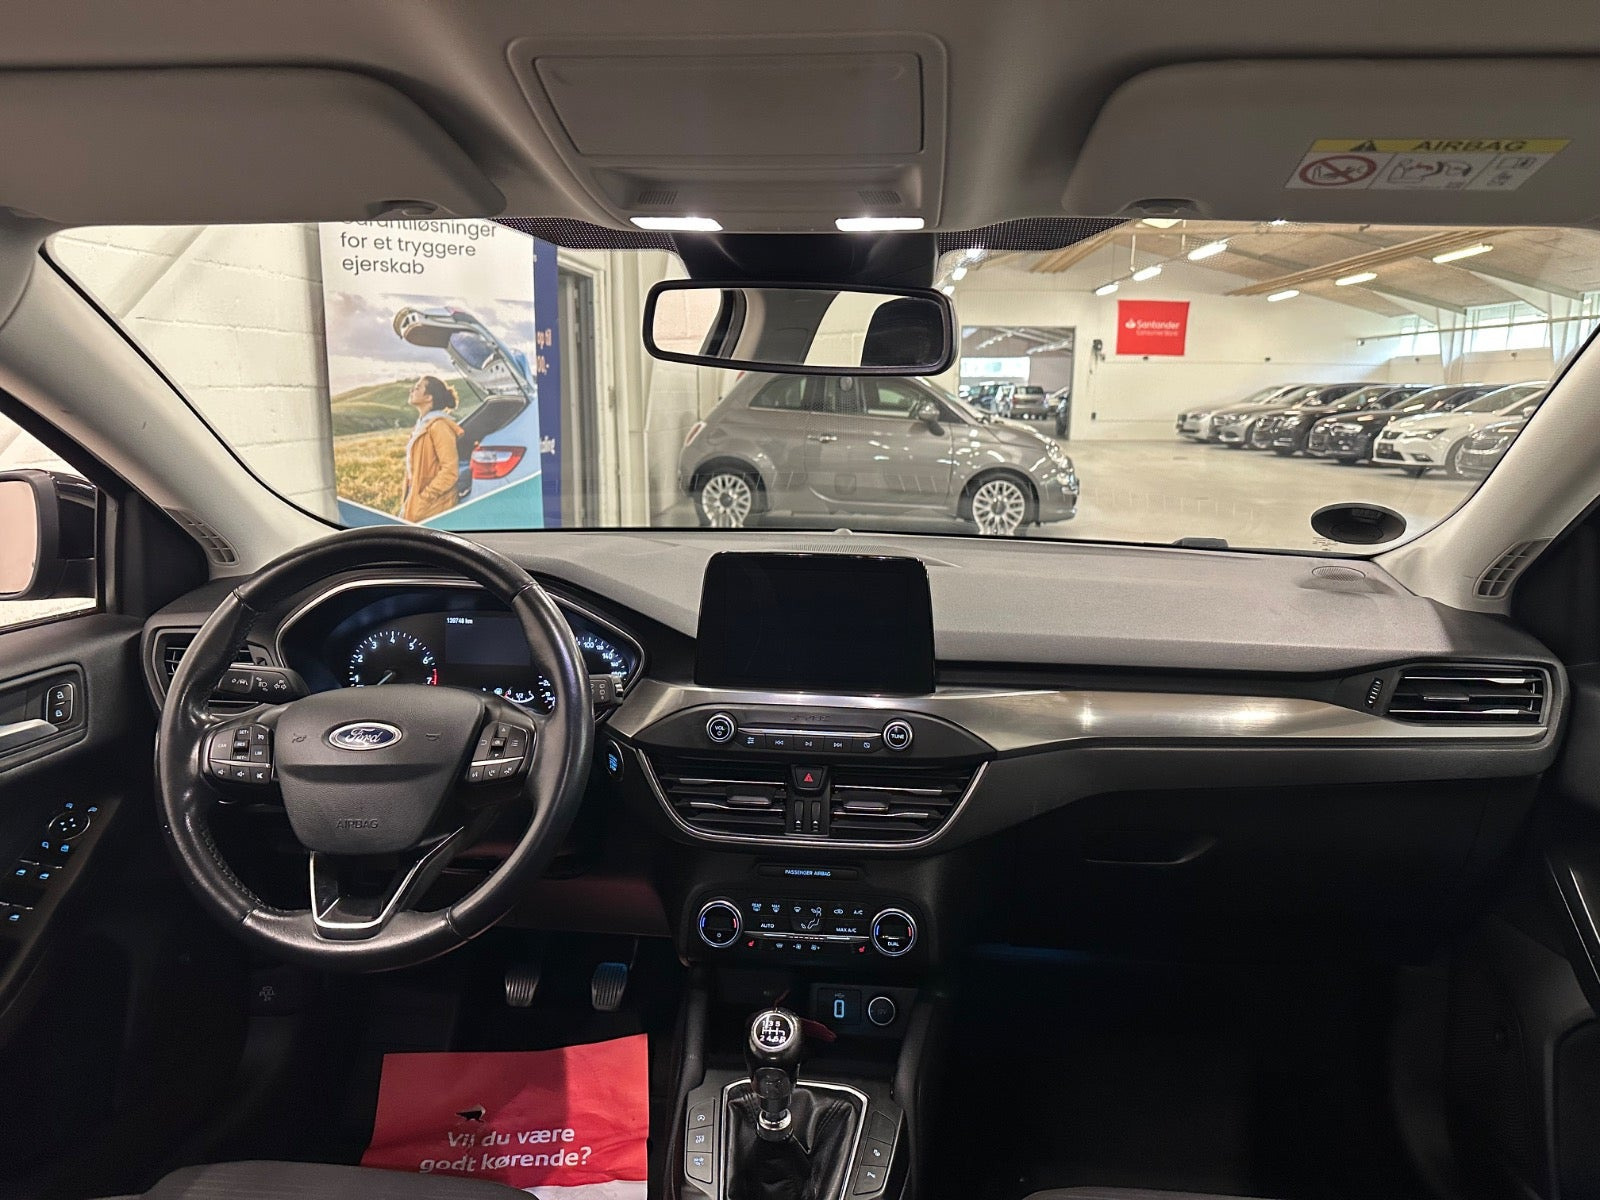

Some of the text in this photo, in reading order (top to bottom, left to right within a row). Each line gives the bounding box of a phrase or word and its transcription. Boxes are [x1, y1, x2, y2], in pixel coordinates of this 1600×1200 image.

[1411, 141, 1526, 151] AIRBAG
[340, 231, 476, 259] for et tryggere
[342, 255, 425, 276] ejerskab
[1136, 319, 1180, 330] Santander
[371, 641, 377, 650] 3
[408, 642, 415, 651] 5
[583, 641, 595, 649] 100
[422, 656, 429, 665] 6
[345, 728, 383, 744] Ford
[335, 818, 379, 829] AIRBAG
[481, 1131, 511, 1147] du
[517, 1128, 575, 1145] være
[419, 1146, 593, 1174] godt kørende?
